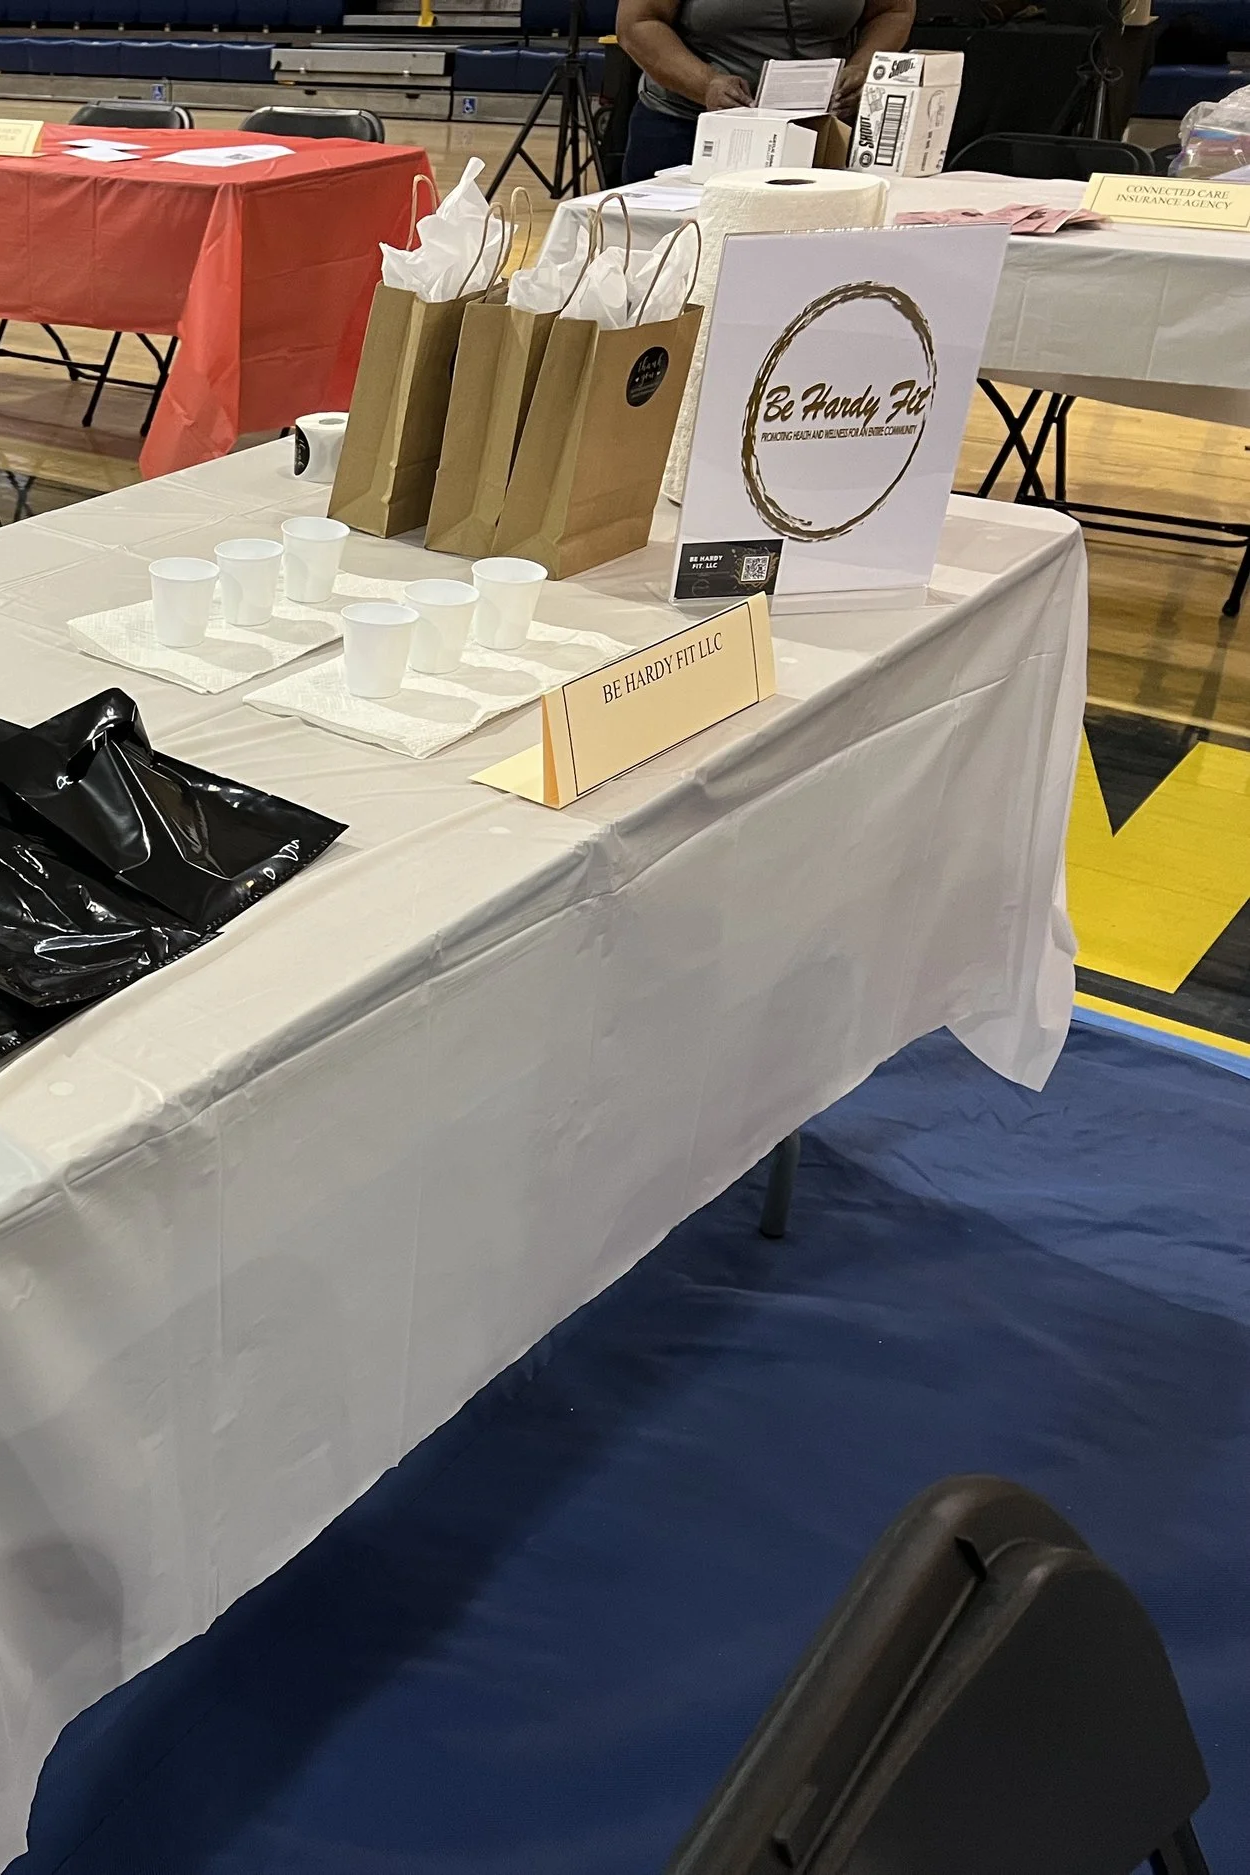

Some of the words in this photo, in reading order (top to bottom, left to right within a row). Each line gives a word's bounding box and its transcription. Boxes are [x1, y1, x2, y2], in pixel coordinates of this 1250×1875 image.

[1126, 184, 1196, 197] CONNECTED
[1197, 189, 1230, 200] CARE
[1116, 194, 1181, 207] INSURANCE
[1182, 200, 1233, 210] AGENCY
[763, 385, 795, 423] Be
[801, 382, 881, 428] Hardy
[885, 379, 932, 425] Fit
[761, 431, 793, 442] PROMOTING
[793, 430, 811, 441] HEALTH
[812, 429, 824, 440] AND
[824, 428, 849, 439] WELLNESS
[850, 427, 860, 438] FOR
[860, 426, 868, 437] AN
[868, 426, 884, 437] ENTIRE
[885, 424, 918, 436] COMMUNITY
[602, 679, 623, 704] BE
[624, 654, 673, 693] HARDY
[675, 644, 696, 669] FIT
[698, 632, 723, 659] LLC
